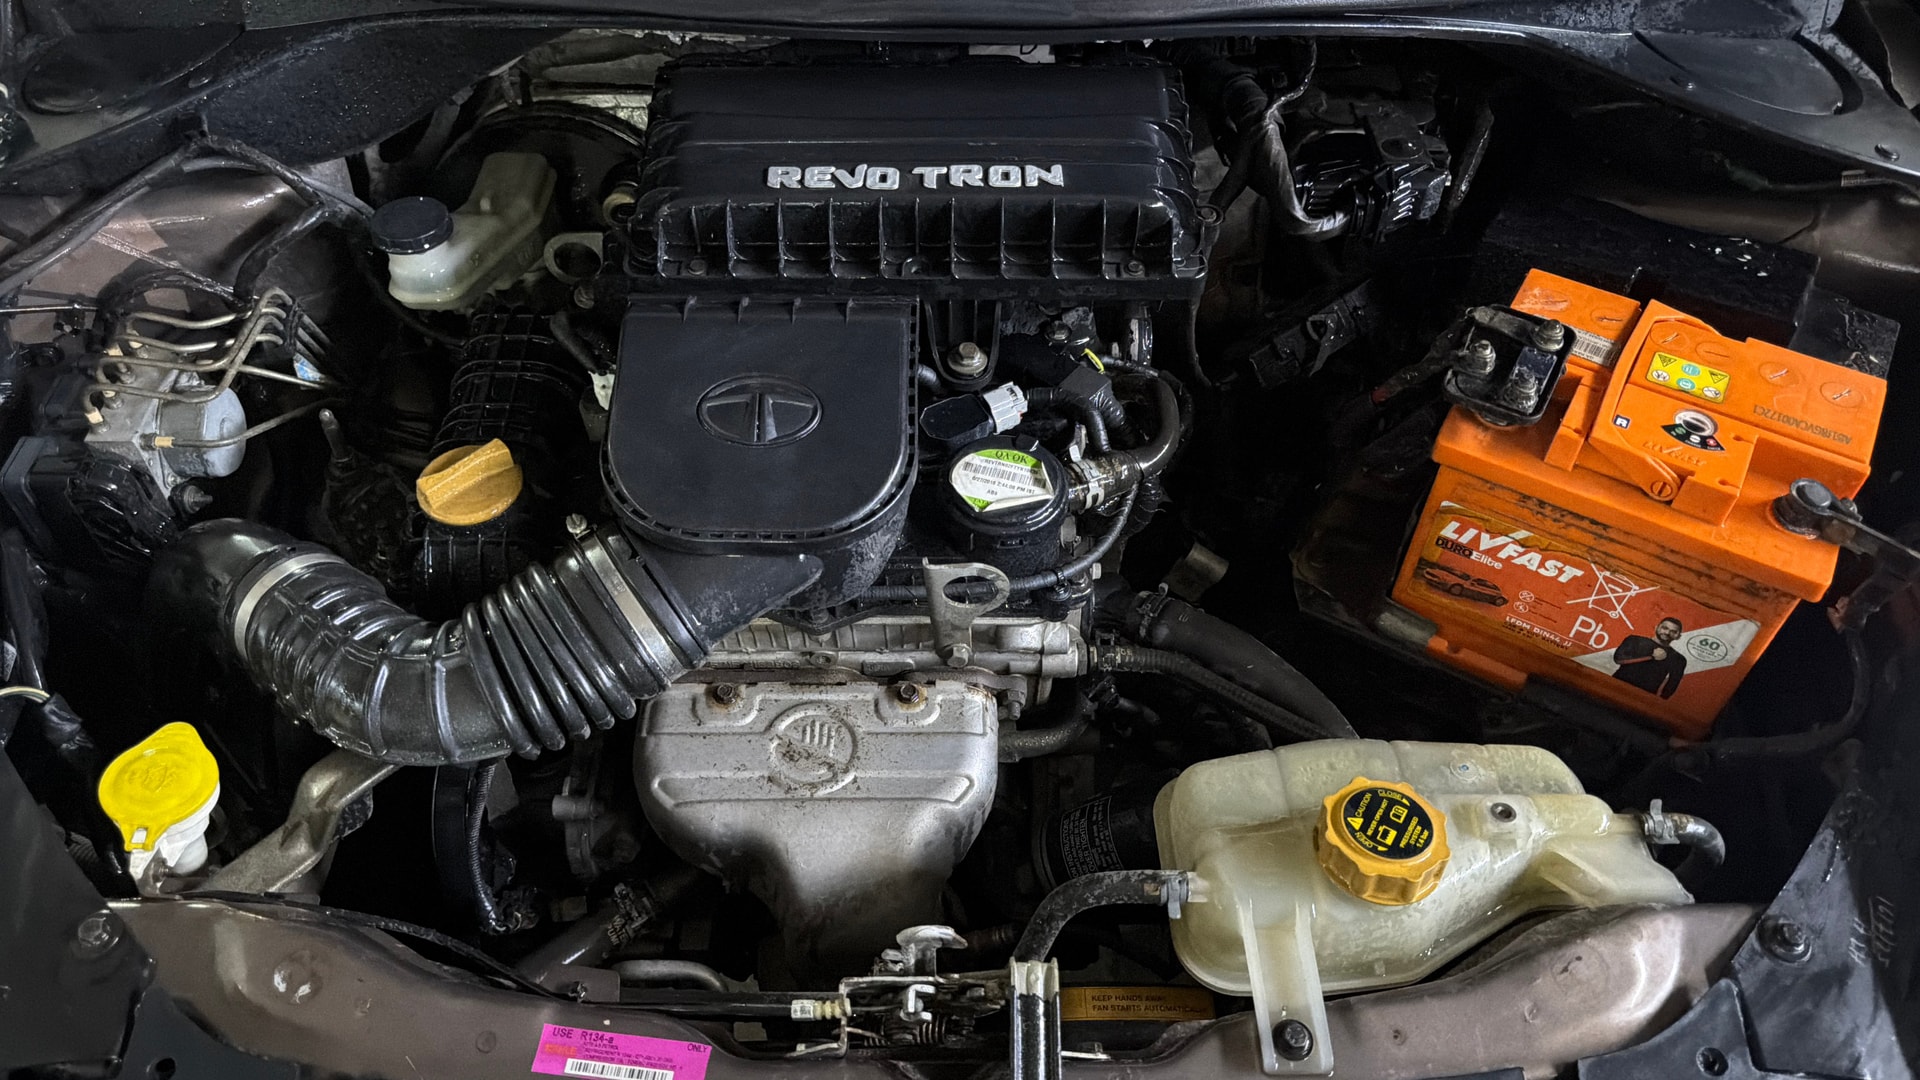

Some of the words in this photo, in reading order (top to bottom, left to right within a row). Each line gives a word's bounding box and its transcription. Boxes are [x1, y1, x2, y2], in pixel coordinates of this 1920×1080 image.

[766, 164, 900, 190] REVO
[911, 164, 1064, 189] TRON
[1439, 520, 1585, 584] LIVFAST
[1569, 615, 1609, 649] Pb
[1699, 638, 1721, 651] 60
[1355, 792, 1373, 818] CAUTION
[1091, 994, 1113, 1002] KEEP
[1115, 994, 1142, 1002] HANDS
[1111, 1004, 1141, 1012] STARTS
[552, 1026, 575, 1039] USE
[580, 1030, 615, 1044] R134-a
[687, 1042, 708, 1053] ONLY
